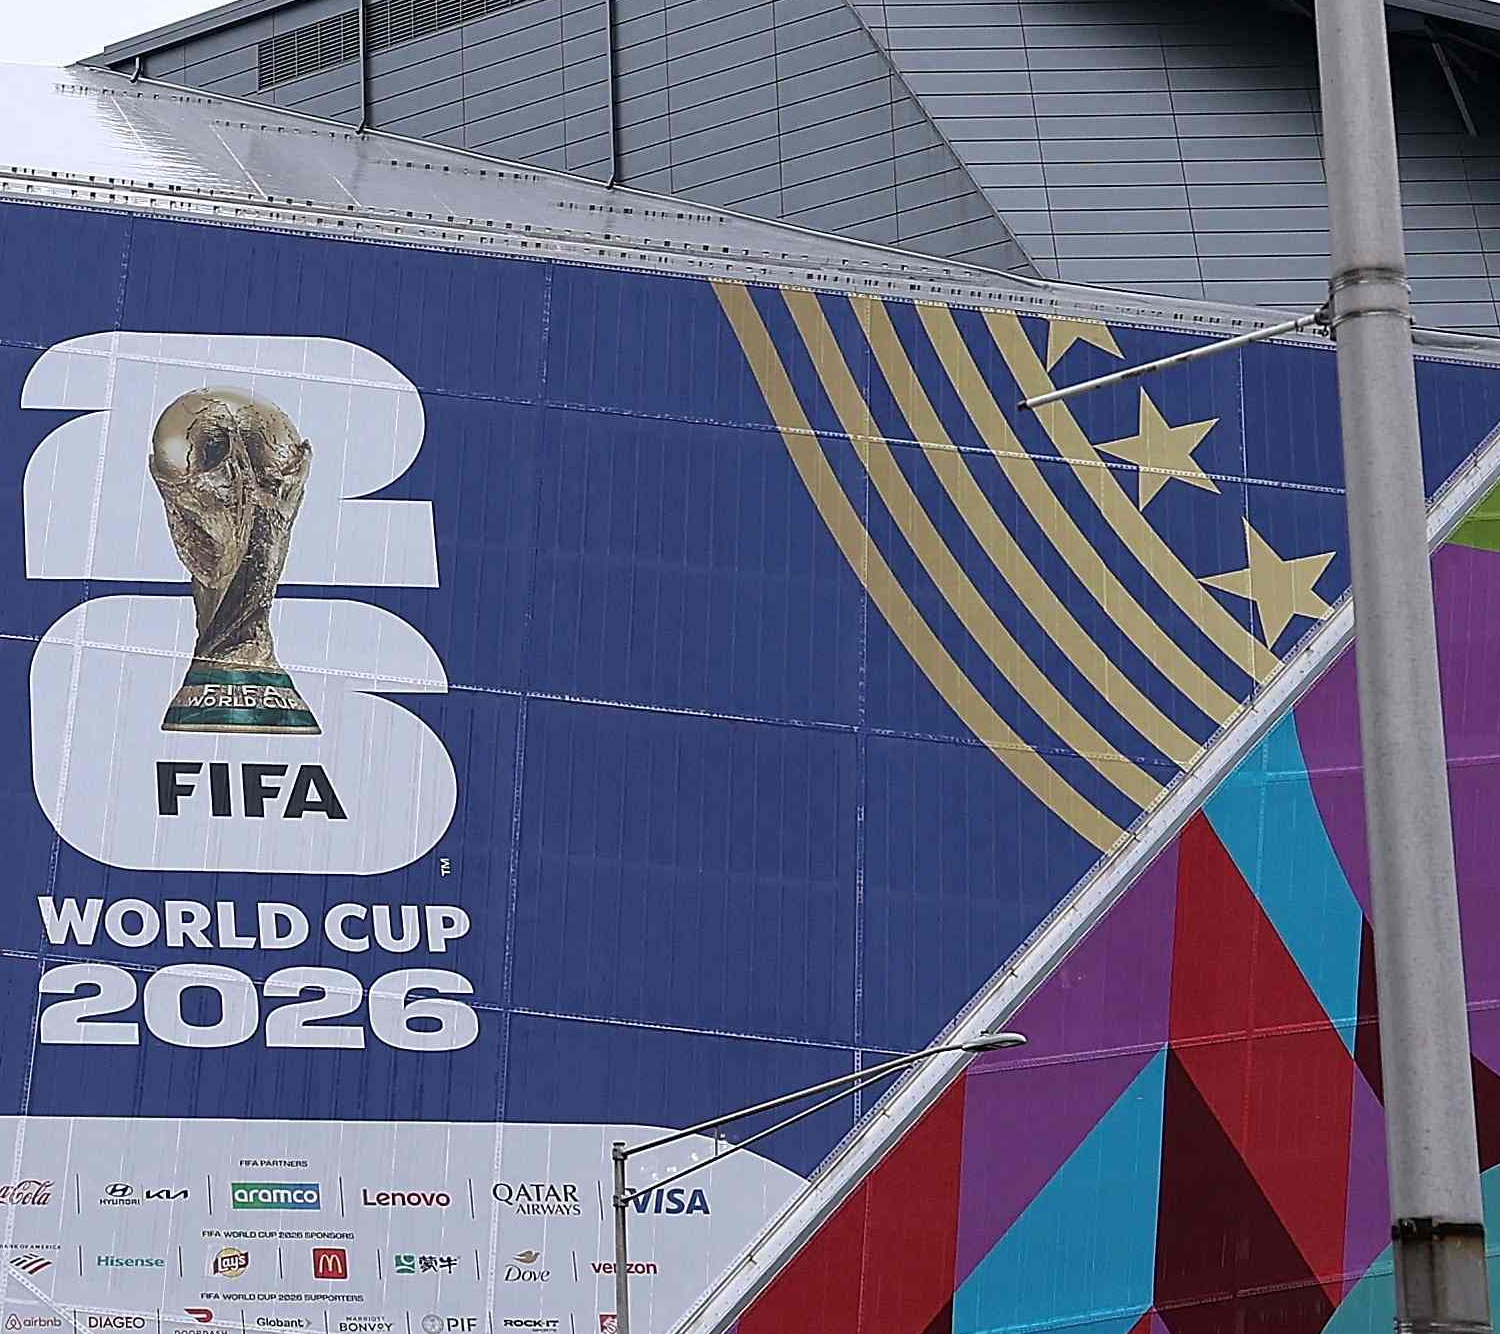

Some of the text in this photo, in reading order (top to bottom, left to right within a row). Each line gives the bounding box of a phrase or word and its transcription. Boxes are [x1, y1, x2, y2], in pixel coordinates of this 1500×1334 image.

[203, 684, 281, 697] FIFA
[188, 695, 299, 710] WORLD CUP
[155, 760, 348, 820] FIFA
[37, 896, 471, 954] WORLD CUP
[37, 963, 480, 1052] 2026
[234, 1189, 318, 1204] aramco
[363, 1188, 451, 1207] Lenovo
[492, 1183, 578, 1205] QATAR
[624, 1188, 711, 1215] VISA
[516, 1204, 581, 1215] AIRWAYS
[202, 1230, 221, 1238] FIFA
[304, 1232, 354, 1240] SPONSORS
[97, 1255, 165, 1268] Hisense
[419, 1255, 458, 1274] 蒙牛
[591, 1262, 658, 1274] vezon
[504, 1266, 550, 1282] Dove
[222, 1293, 255, 1301] WORLD
[257, 1293, 276, 1301] CUP
[304, 1294, 364, 1302] SUPPORTERS
[23, 1318, 62, 1328] airbnb
[88, 1316, 146, 1329] DIAGEO
[256, 1317, 304, 1328] Globant
[339, 1322, 393, 1332] BONVOY
[447, 1318, 477, 1332] PIF
[504, 1319, 559, 1327] ROCK-IT
